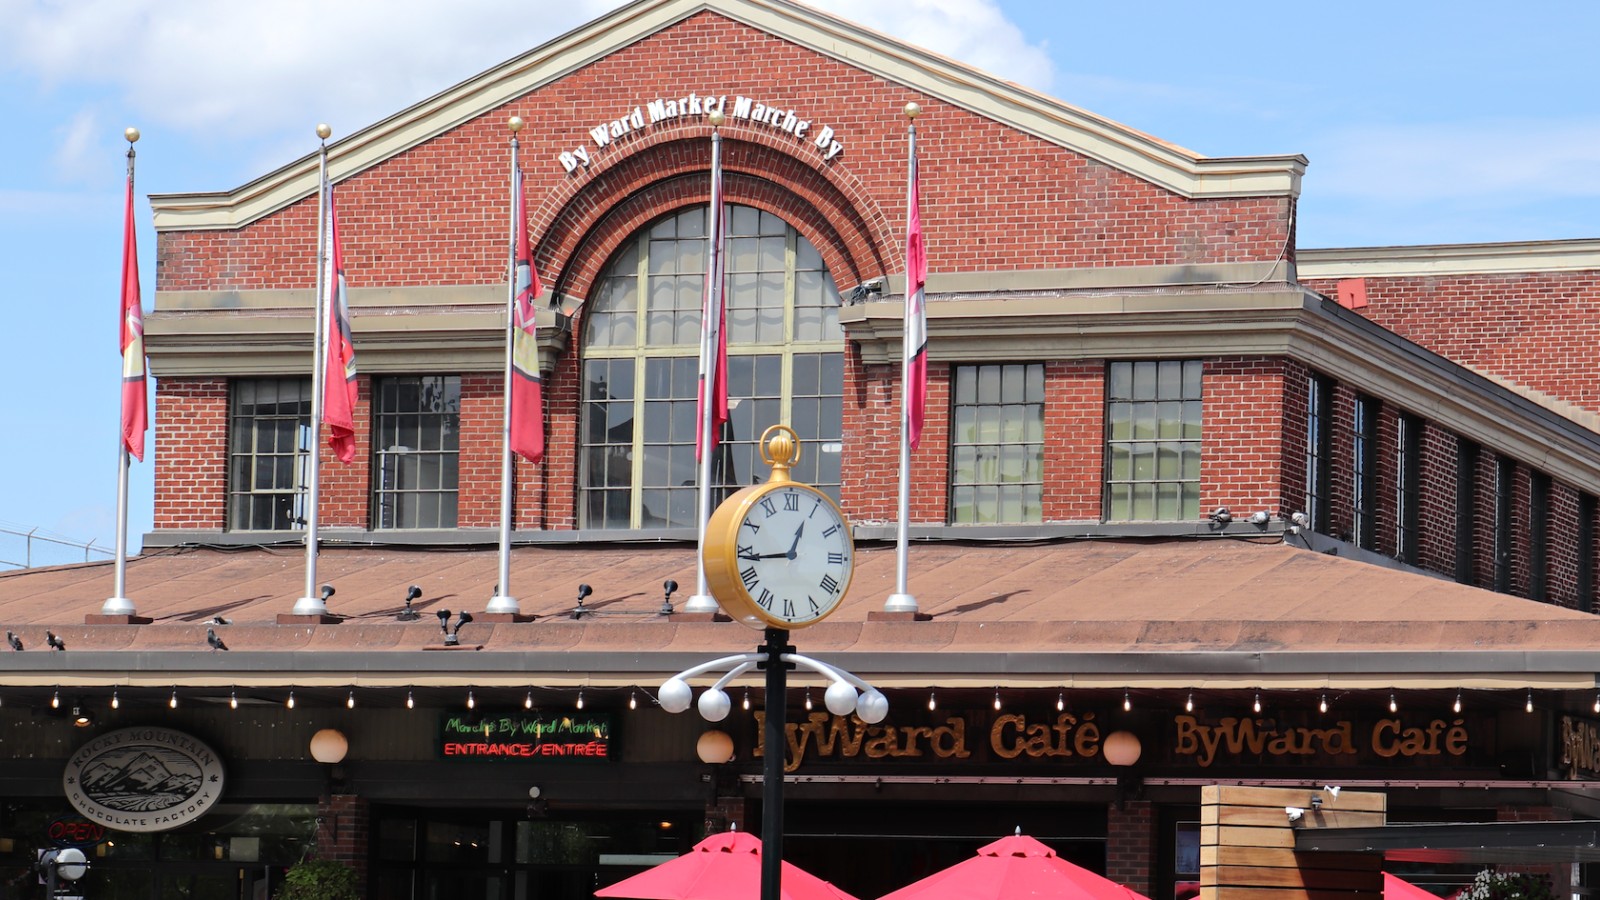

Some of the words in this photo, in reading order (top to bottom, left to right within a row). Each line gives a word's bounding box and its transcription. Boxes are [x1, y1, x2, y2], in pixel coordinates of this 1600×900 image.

[558, 145, 590, 173] By
[589, 106, 645, 147] Ward
[647, 93, 727, 123] Market
[814, 124, 844, 161] By
[760, 497, 777, 518] XI
[784, 493, 799, 511] XII
[499, 718, 518, 737] By
[520, 718, 556, 733] Ward
[990, 712, 1100, 759] Café
[1174, 715, 1357, 767] ByWard
[1371, 718, 1468, 757] Café
[73, 733, 123, 768] ROCKY
[129, 731, 214, 767] MOUNTAIN
[444, 741, 607, 757] ENTRANCE/ENTRÉE
[73, 792, 147, 826] CHOCOLATE
[155, 791, 210, 824] FACTORY
[48, 820, 104, 841] OPEN
